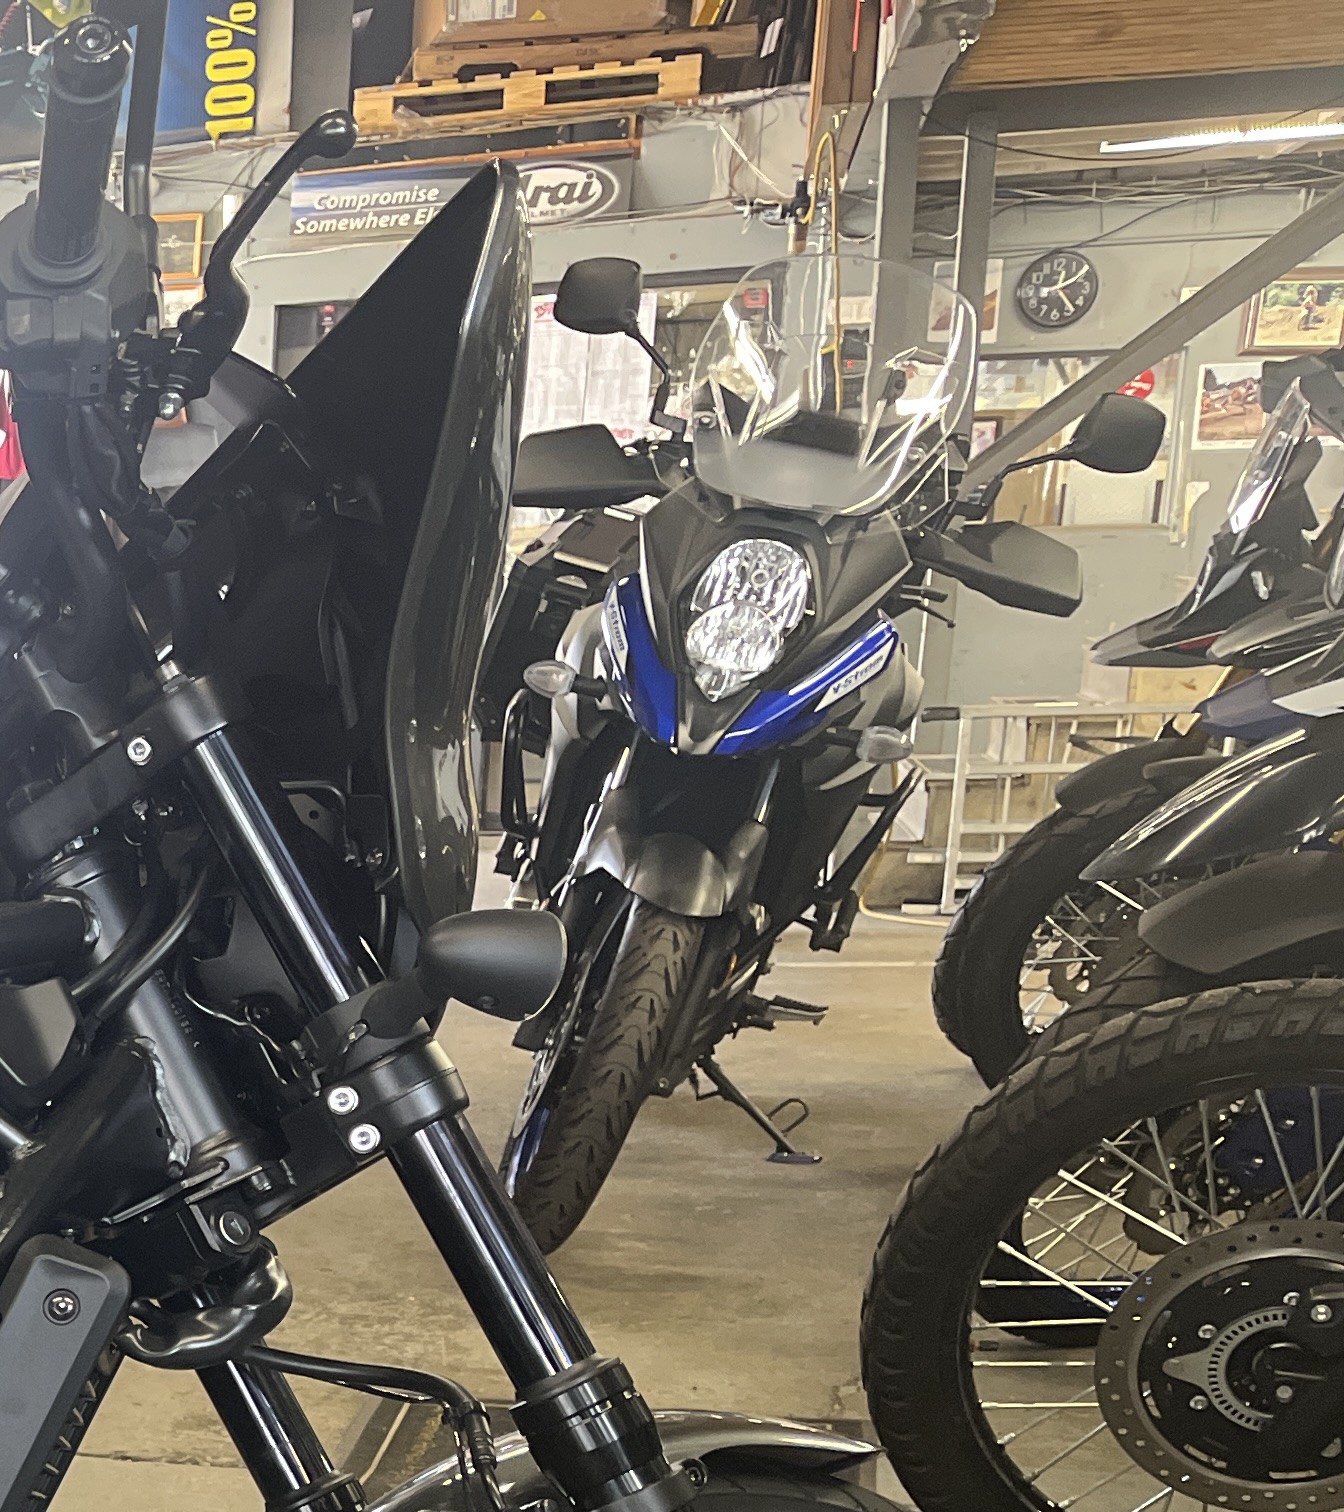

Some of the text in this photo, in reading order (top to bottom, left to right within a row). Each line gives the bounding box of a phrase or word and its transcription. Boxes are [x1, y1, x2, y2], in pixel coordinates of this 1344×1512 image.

[205, 1, 257, 141] 100%
[313, 185, 439, 210] Compromise
[520, 170, 596, 207] rai
[294, 211, 409, 235] Somewhere
